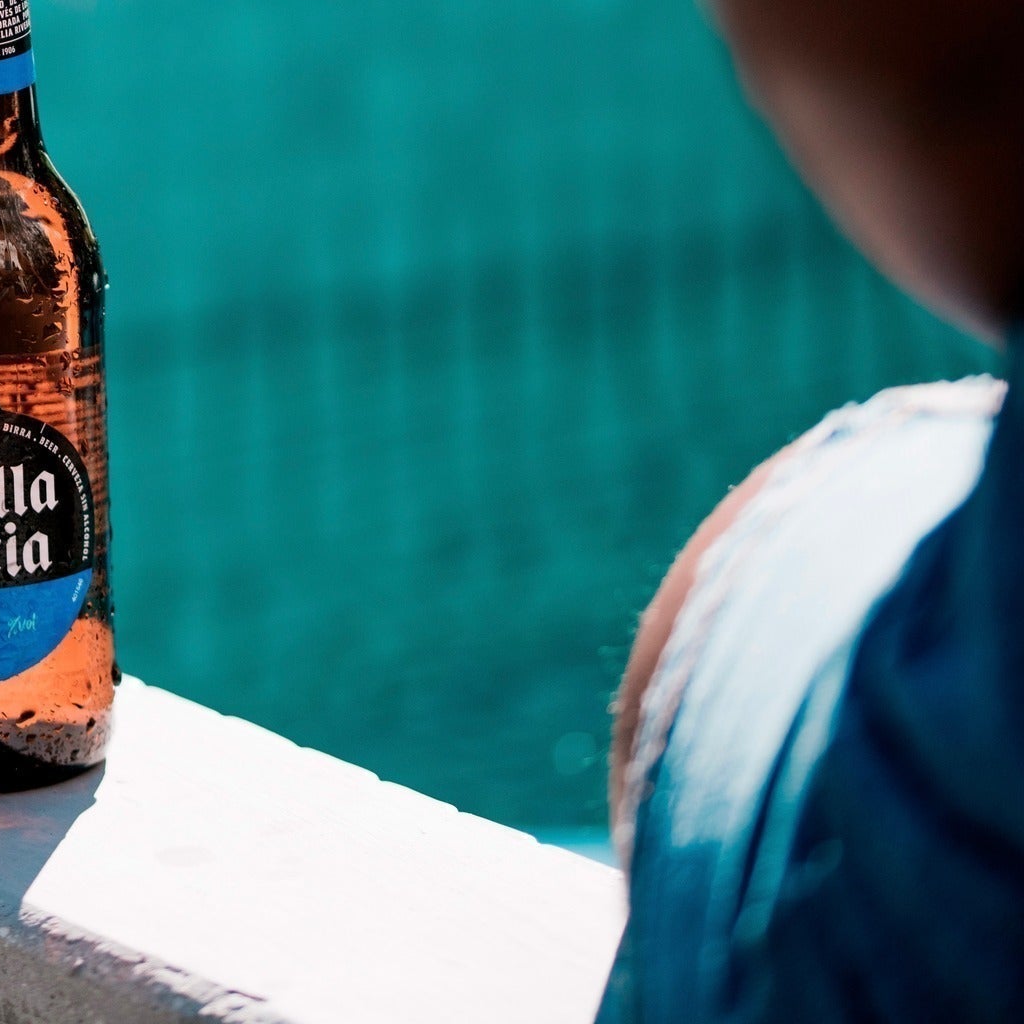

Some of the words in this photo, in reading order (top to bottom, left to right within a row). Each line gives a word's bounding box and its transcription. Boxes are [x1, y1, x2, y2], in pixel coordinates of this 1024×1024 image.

[14, 4, 22, 14] DE
[2, 46, 16, 56] 1906
[2, 423, 32, 439] BIRRA
[38, 436, 59, 454] BEER
[62, 454, 84, 493] CERVEZA
[80, 493, 88, 511] SIN
